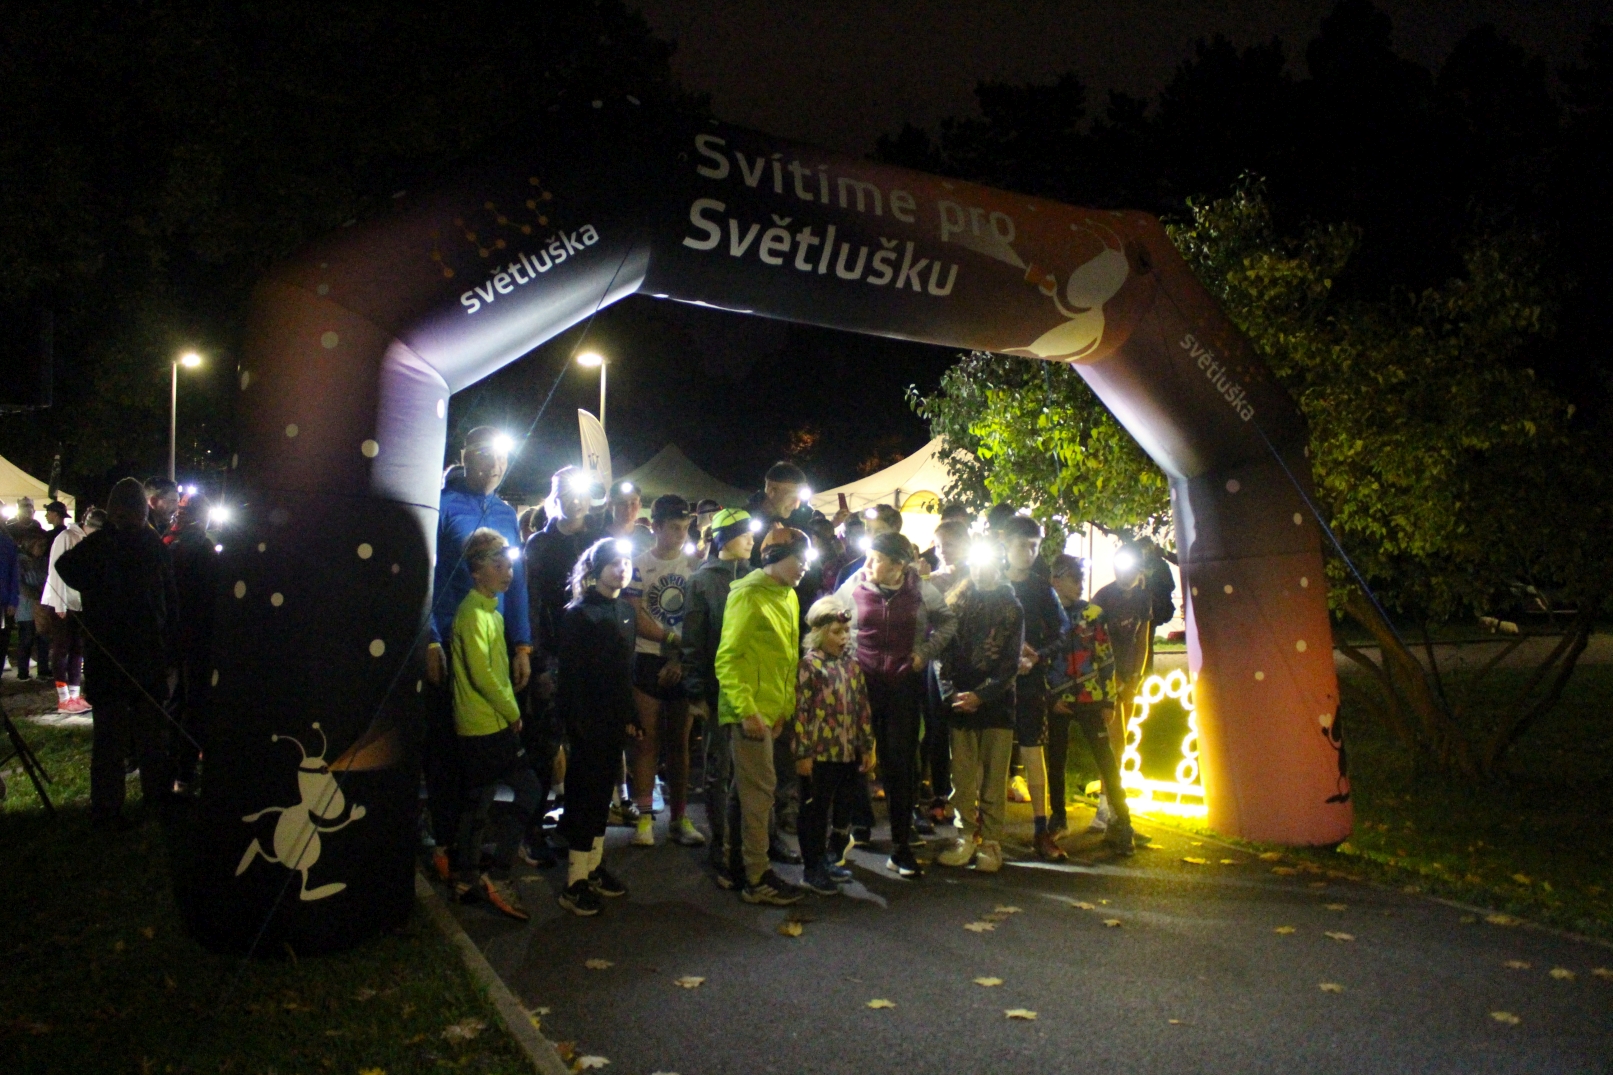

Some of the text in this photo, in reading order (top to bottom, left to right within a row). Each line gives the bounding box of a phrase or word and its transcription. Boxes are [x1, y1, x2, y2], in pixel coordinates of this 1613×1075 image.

[694, 133, 1016, 242] Svítíme pro
[460, 223, 600, 314] světluška
[682, 197, 960, 296] Světlušku
[1179, 333, 1255, 422] světluška
